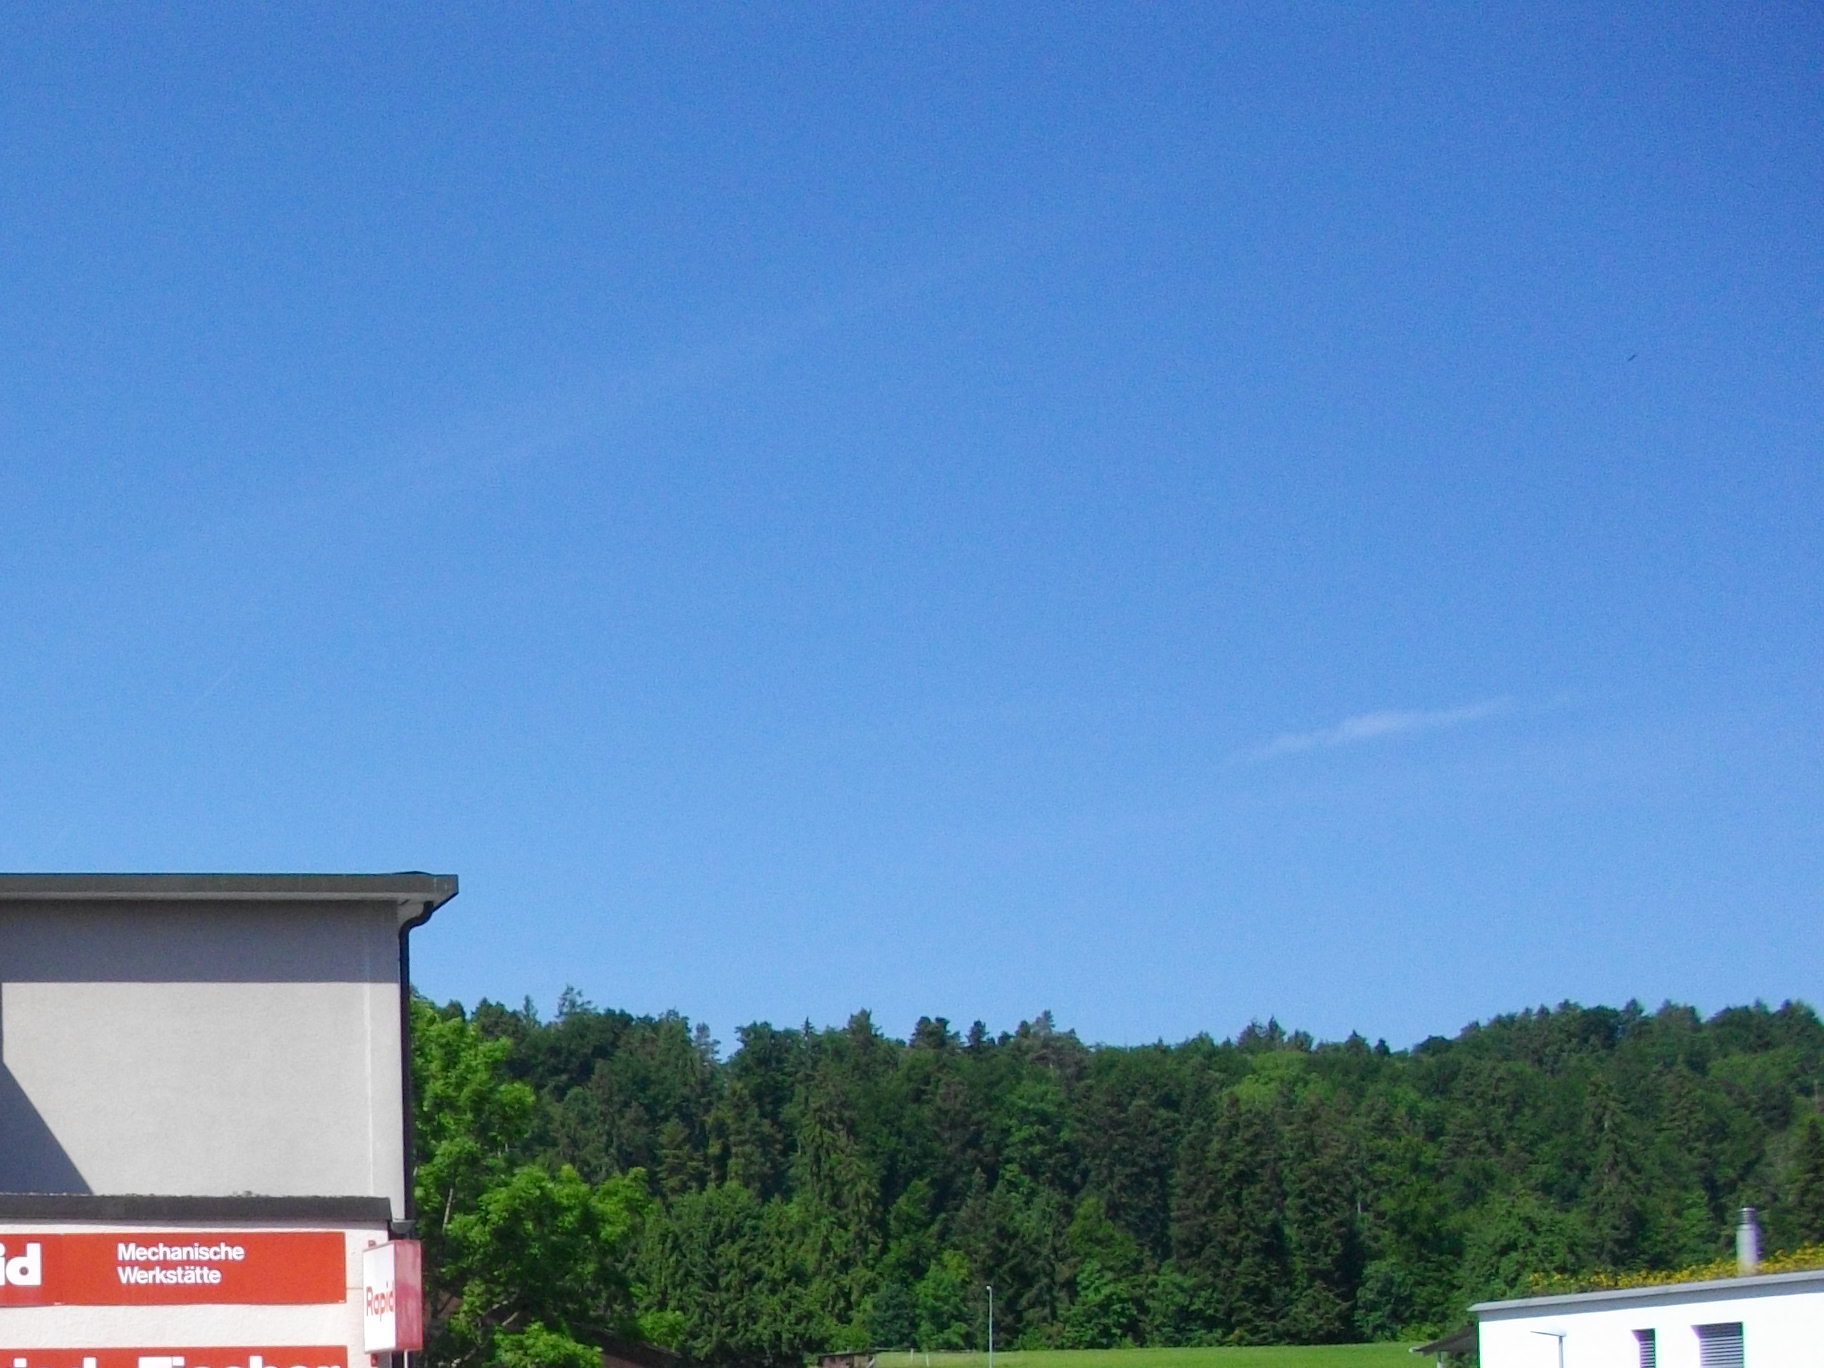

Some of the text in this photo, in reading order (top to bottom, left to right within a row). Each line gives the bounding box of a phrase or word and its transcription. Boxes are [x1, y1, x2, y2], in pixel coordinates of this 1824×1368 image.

[116, 1241, 245, 1262] Mechanische
[116, 1264, 222, 1285] Werkstätte
[366, 1281, 395, 1323] Rapid
